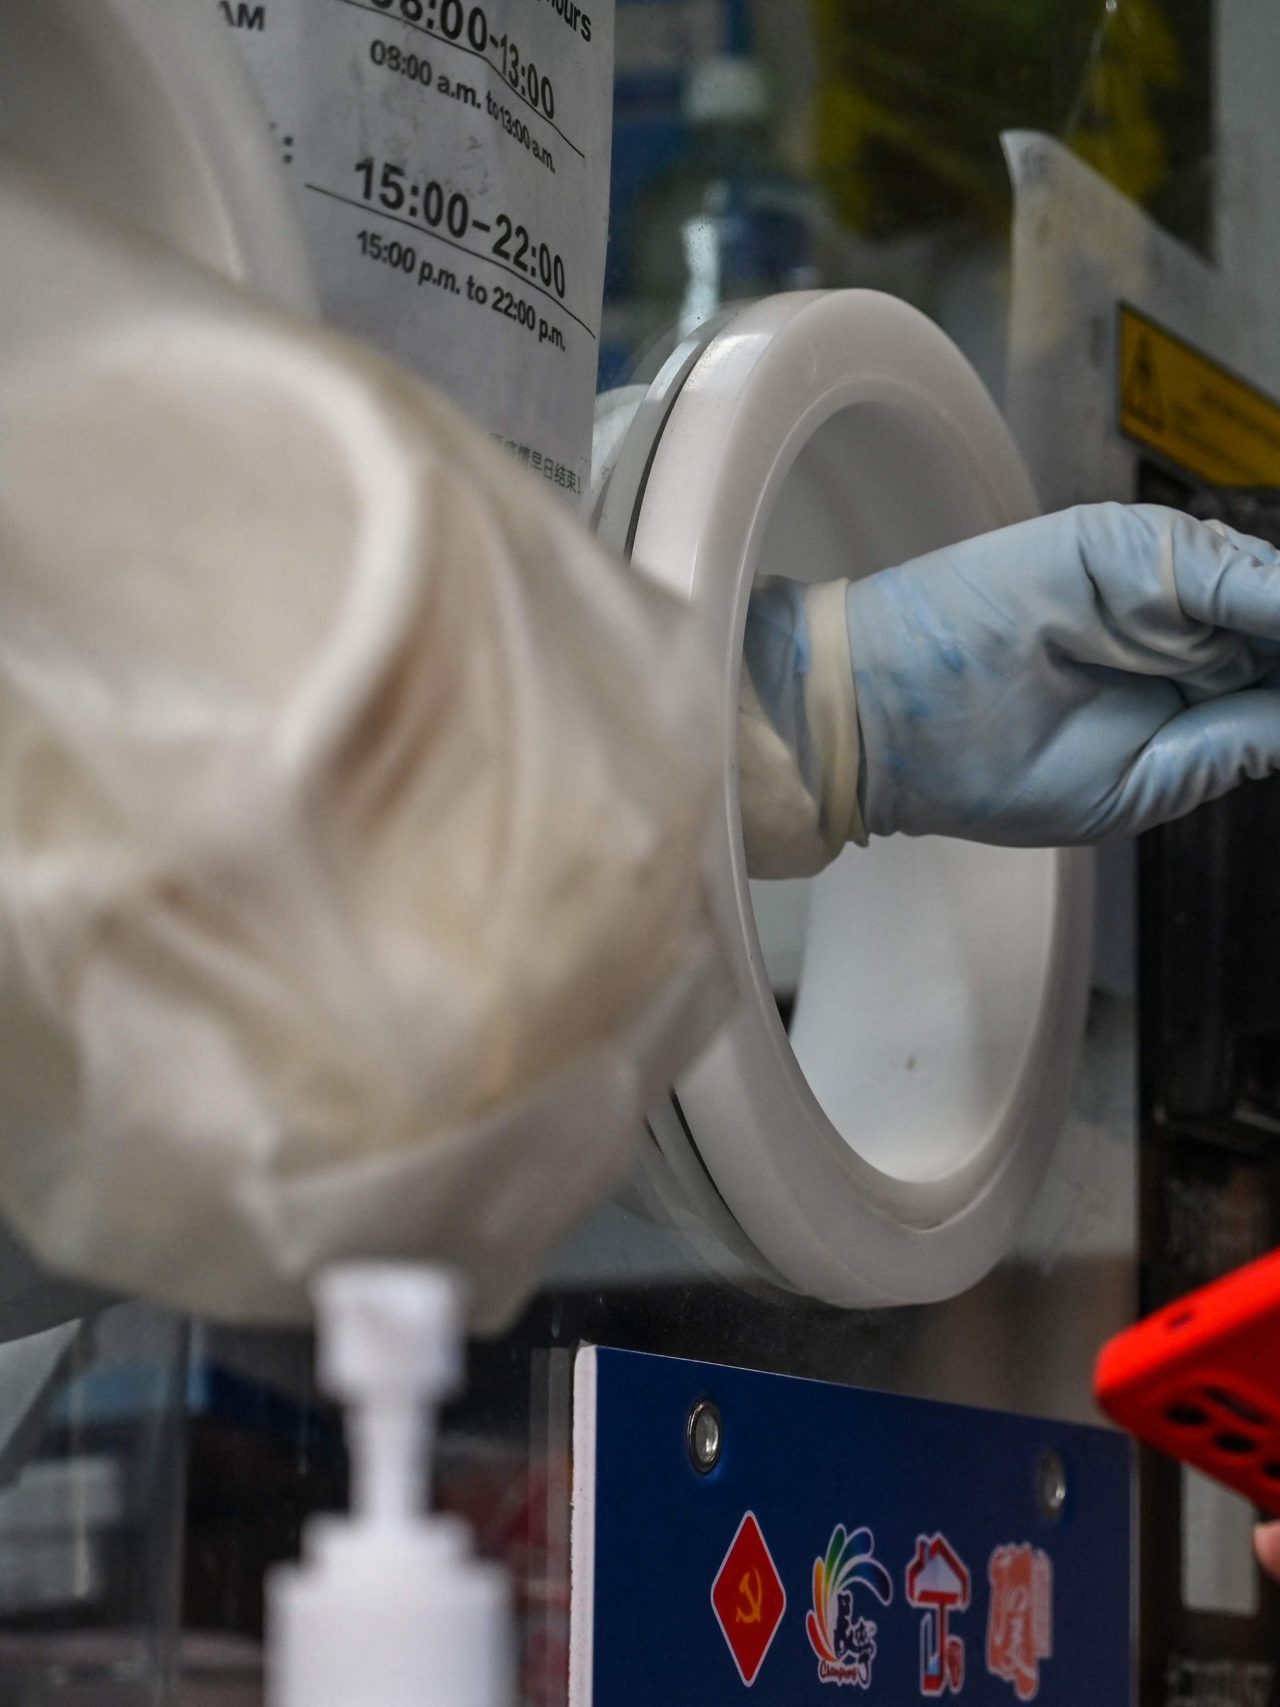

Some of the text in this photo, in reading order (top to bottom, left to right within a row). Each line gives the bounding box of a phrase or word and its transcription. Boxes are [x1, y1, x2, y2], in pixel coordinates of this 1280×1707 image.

[371, 0, 555, 120] :00-13:00
[546, 0, 592, 43] ours
[370, 39, 556, 174] 08:00 a.m. to 13:00 a.m.
[355, 156, 565, 299] 15:00-22:00
[356, 230, 566, 352] 15:00 p.m. to 22:00 p.m.
